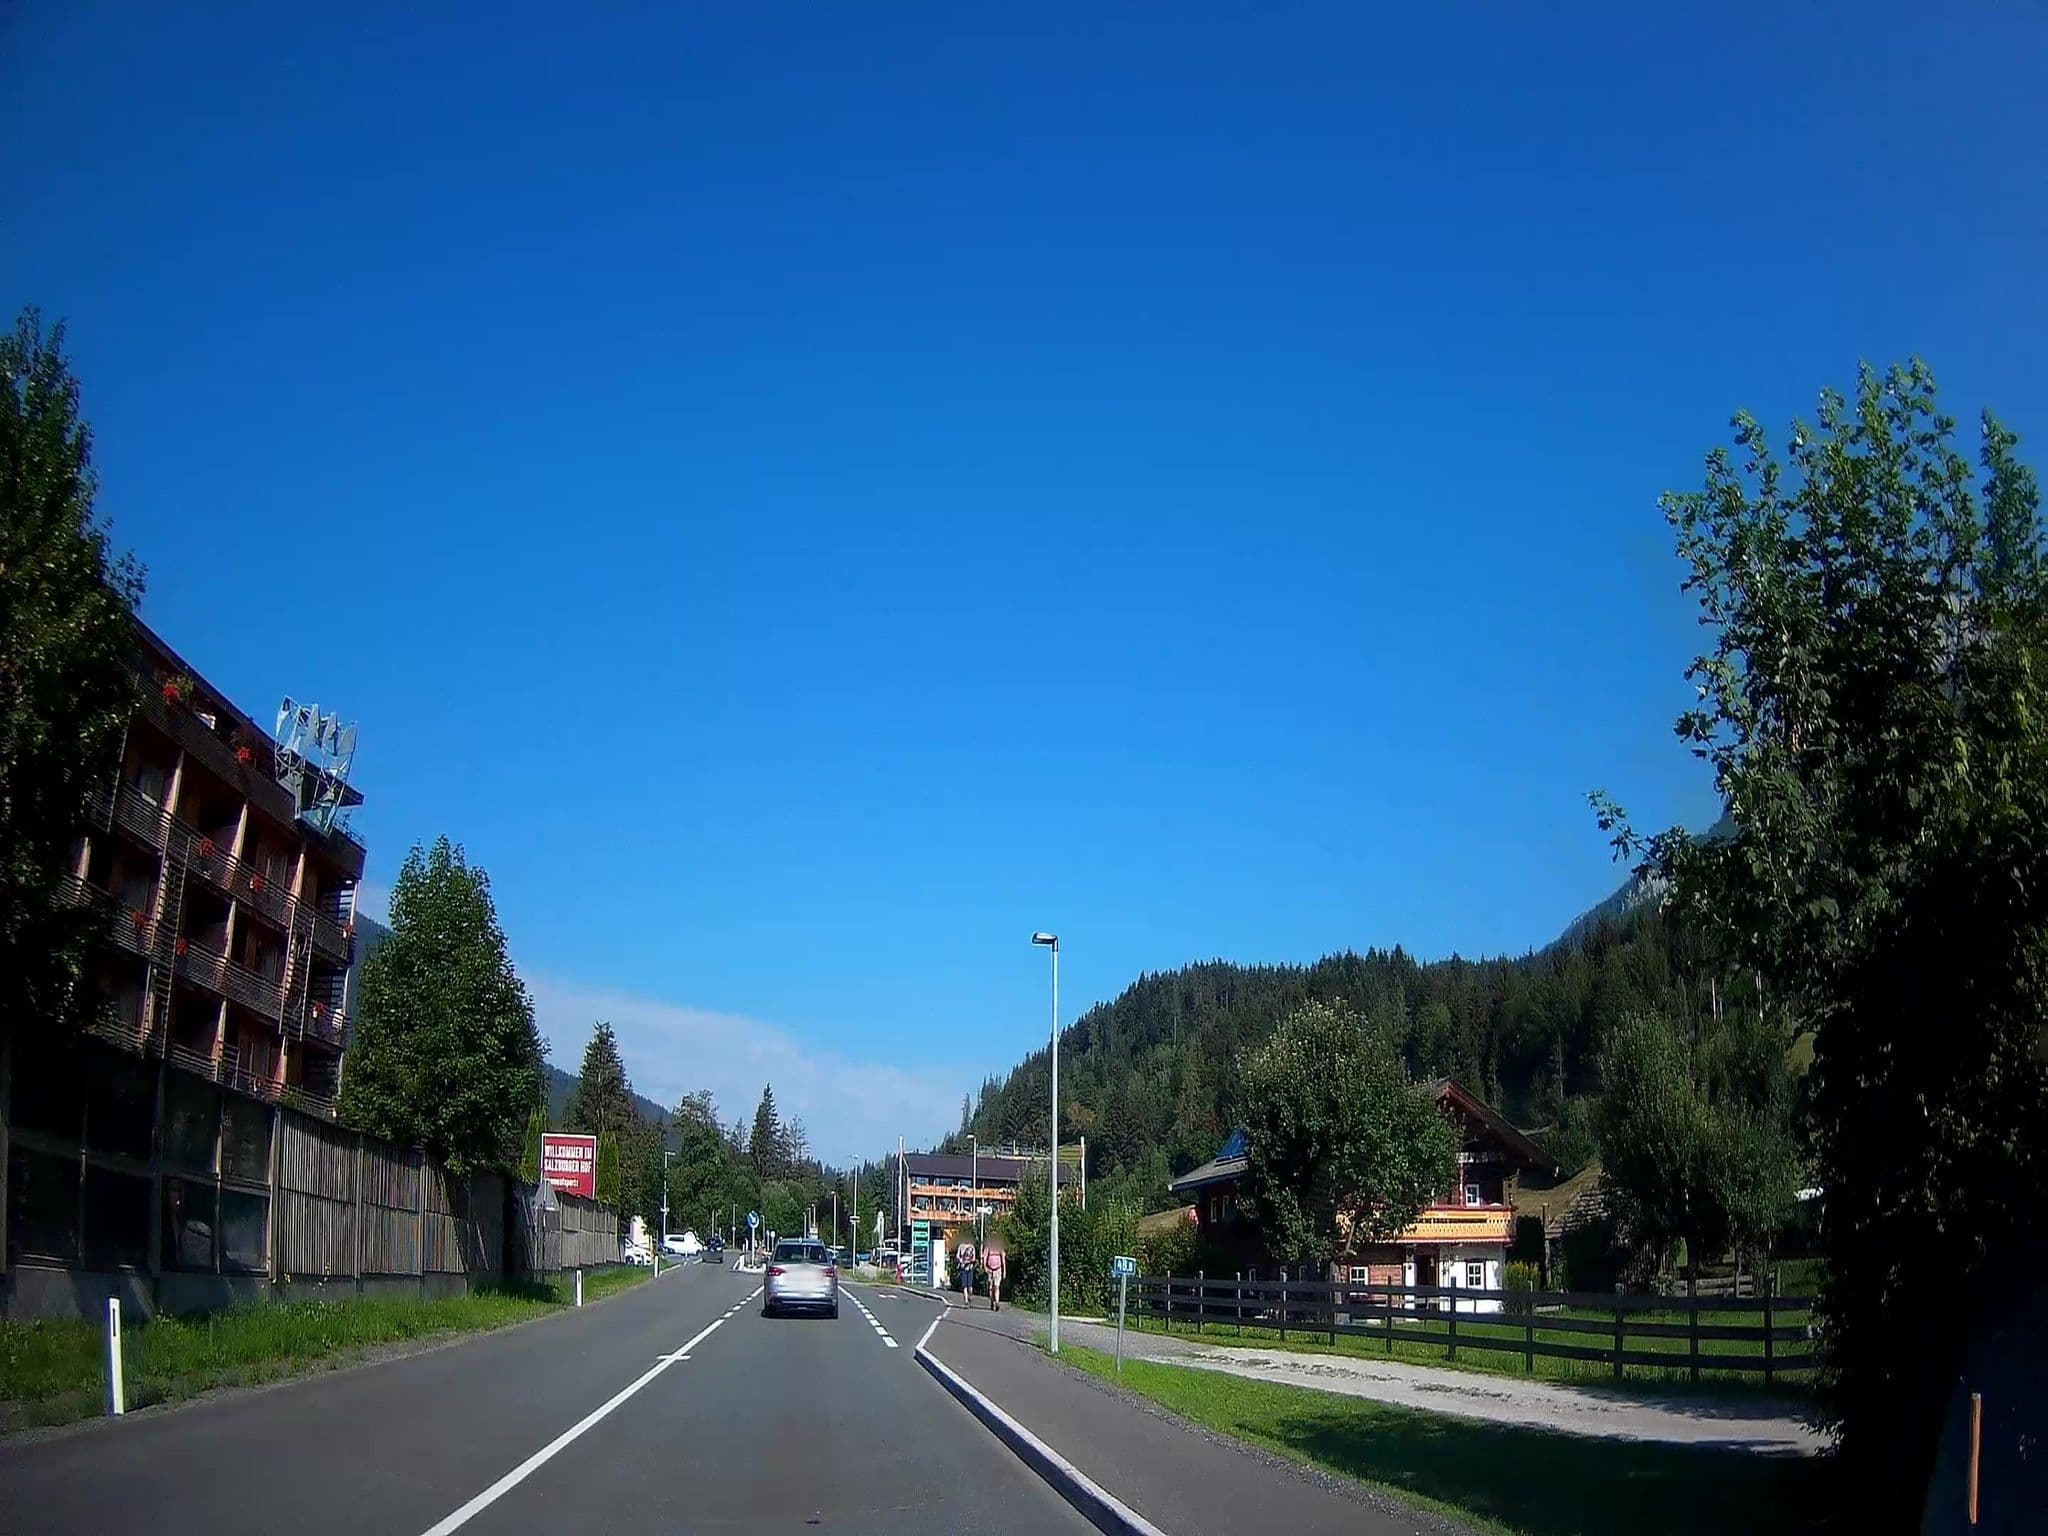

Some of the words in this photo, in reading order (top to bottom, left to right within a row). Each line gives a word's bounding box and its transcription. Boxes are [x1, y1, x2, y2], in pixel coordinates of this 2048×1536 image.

[544, 1144, 583, 1159] WILLKOMMEN
[544, 1159, 579, 1173] SALZBURGER
[580, 1160, 592, 1174] HOF
